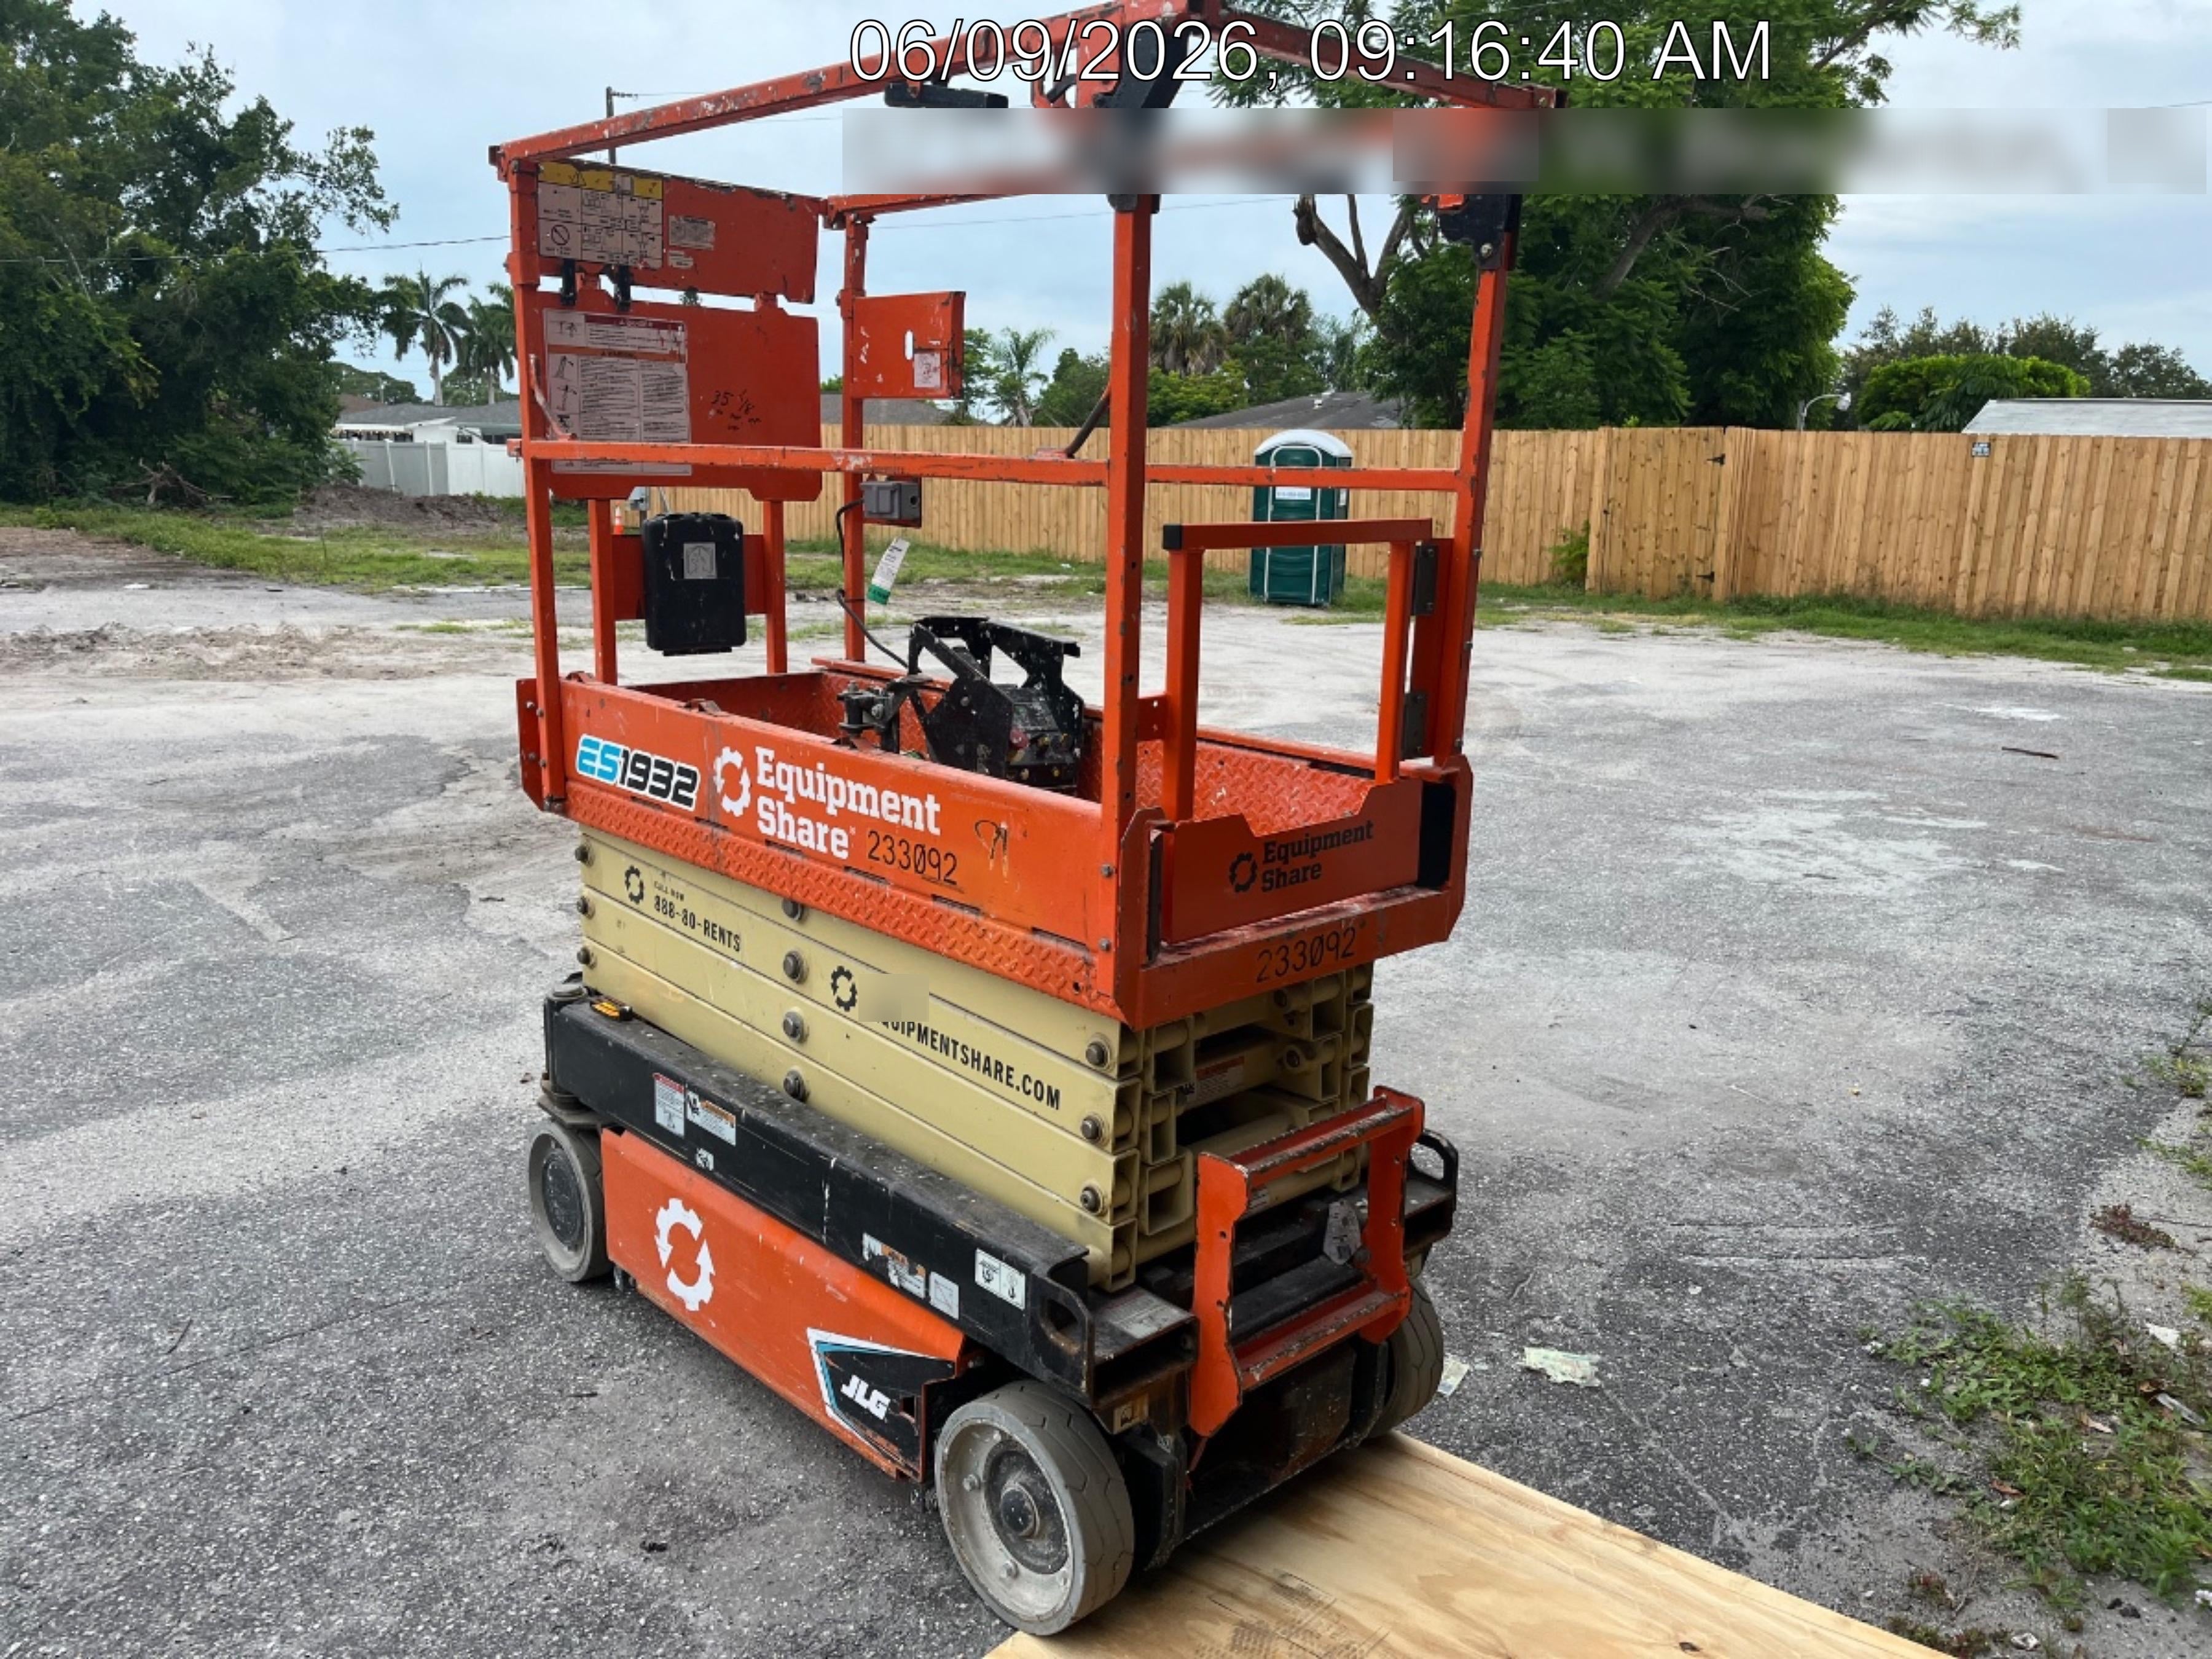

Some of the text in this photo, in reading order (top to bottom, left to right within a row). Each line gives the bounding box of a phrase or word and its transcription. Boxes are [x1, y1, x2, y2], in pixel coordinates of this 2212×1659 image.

[577, 736, 700, 804] ES1932
[755, 746, 941, 836] Equipment
[868, 830, 957, 885] 233092
[1263, 820, 1374, 865] Equipment
[1261, 861, 1322, 893] Share
[654, 894, 740, 952] 888-80-RENTS
[1256, 926, 1356, 983] 233092
[841, 1375, 891, 1420] JLG
